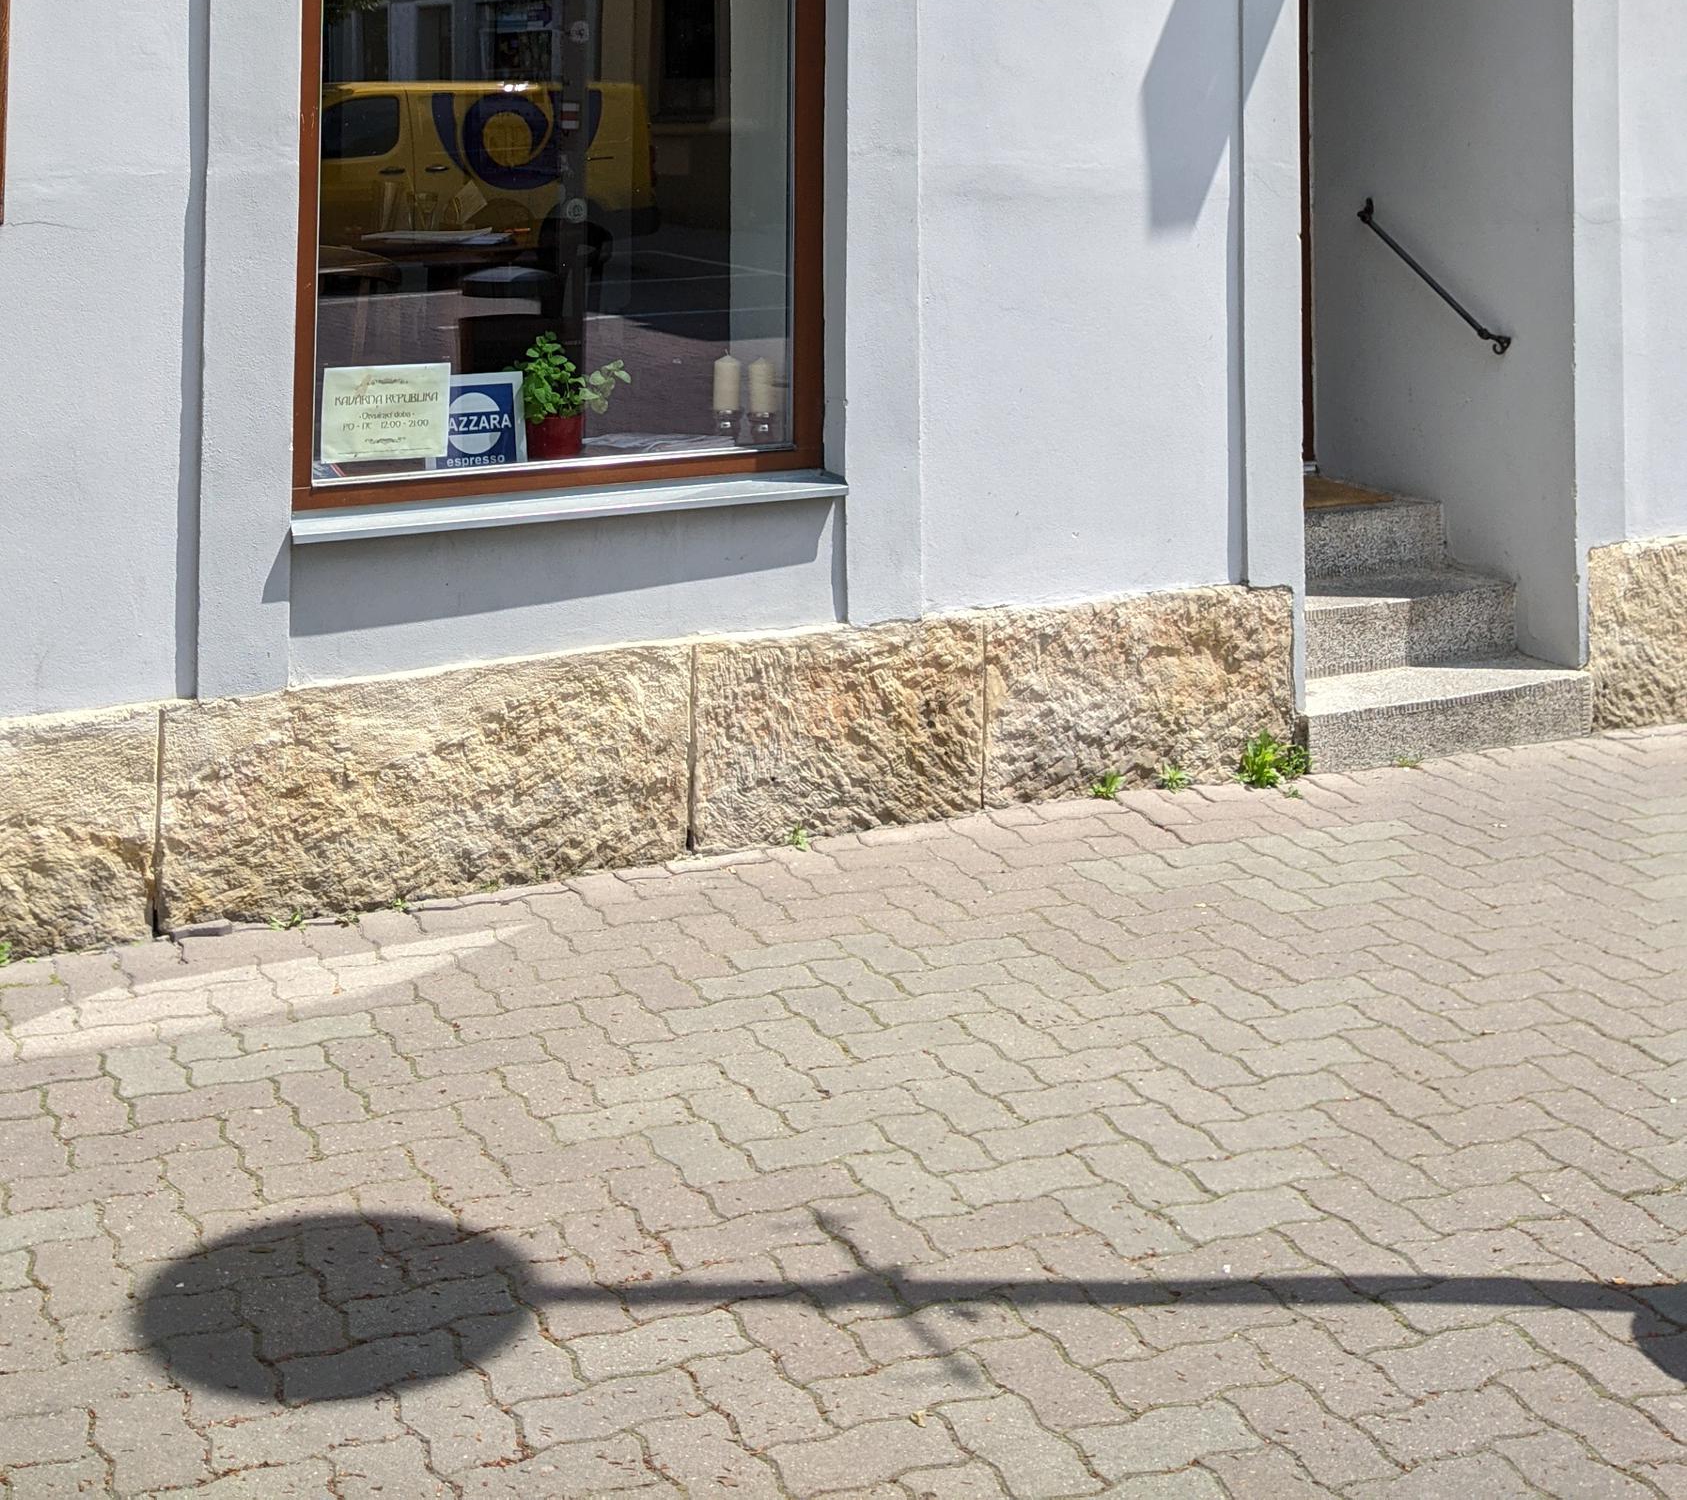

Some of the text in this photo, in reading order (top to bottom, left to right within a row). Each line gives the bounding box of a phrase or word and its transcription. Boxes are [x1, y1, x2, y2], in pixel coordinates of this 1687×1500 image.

[385, 391, 438, 404] REPUBLIKA
[448, 413, 512, 432] AZZARA
[446, 454, 506, 468] espresso
